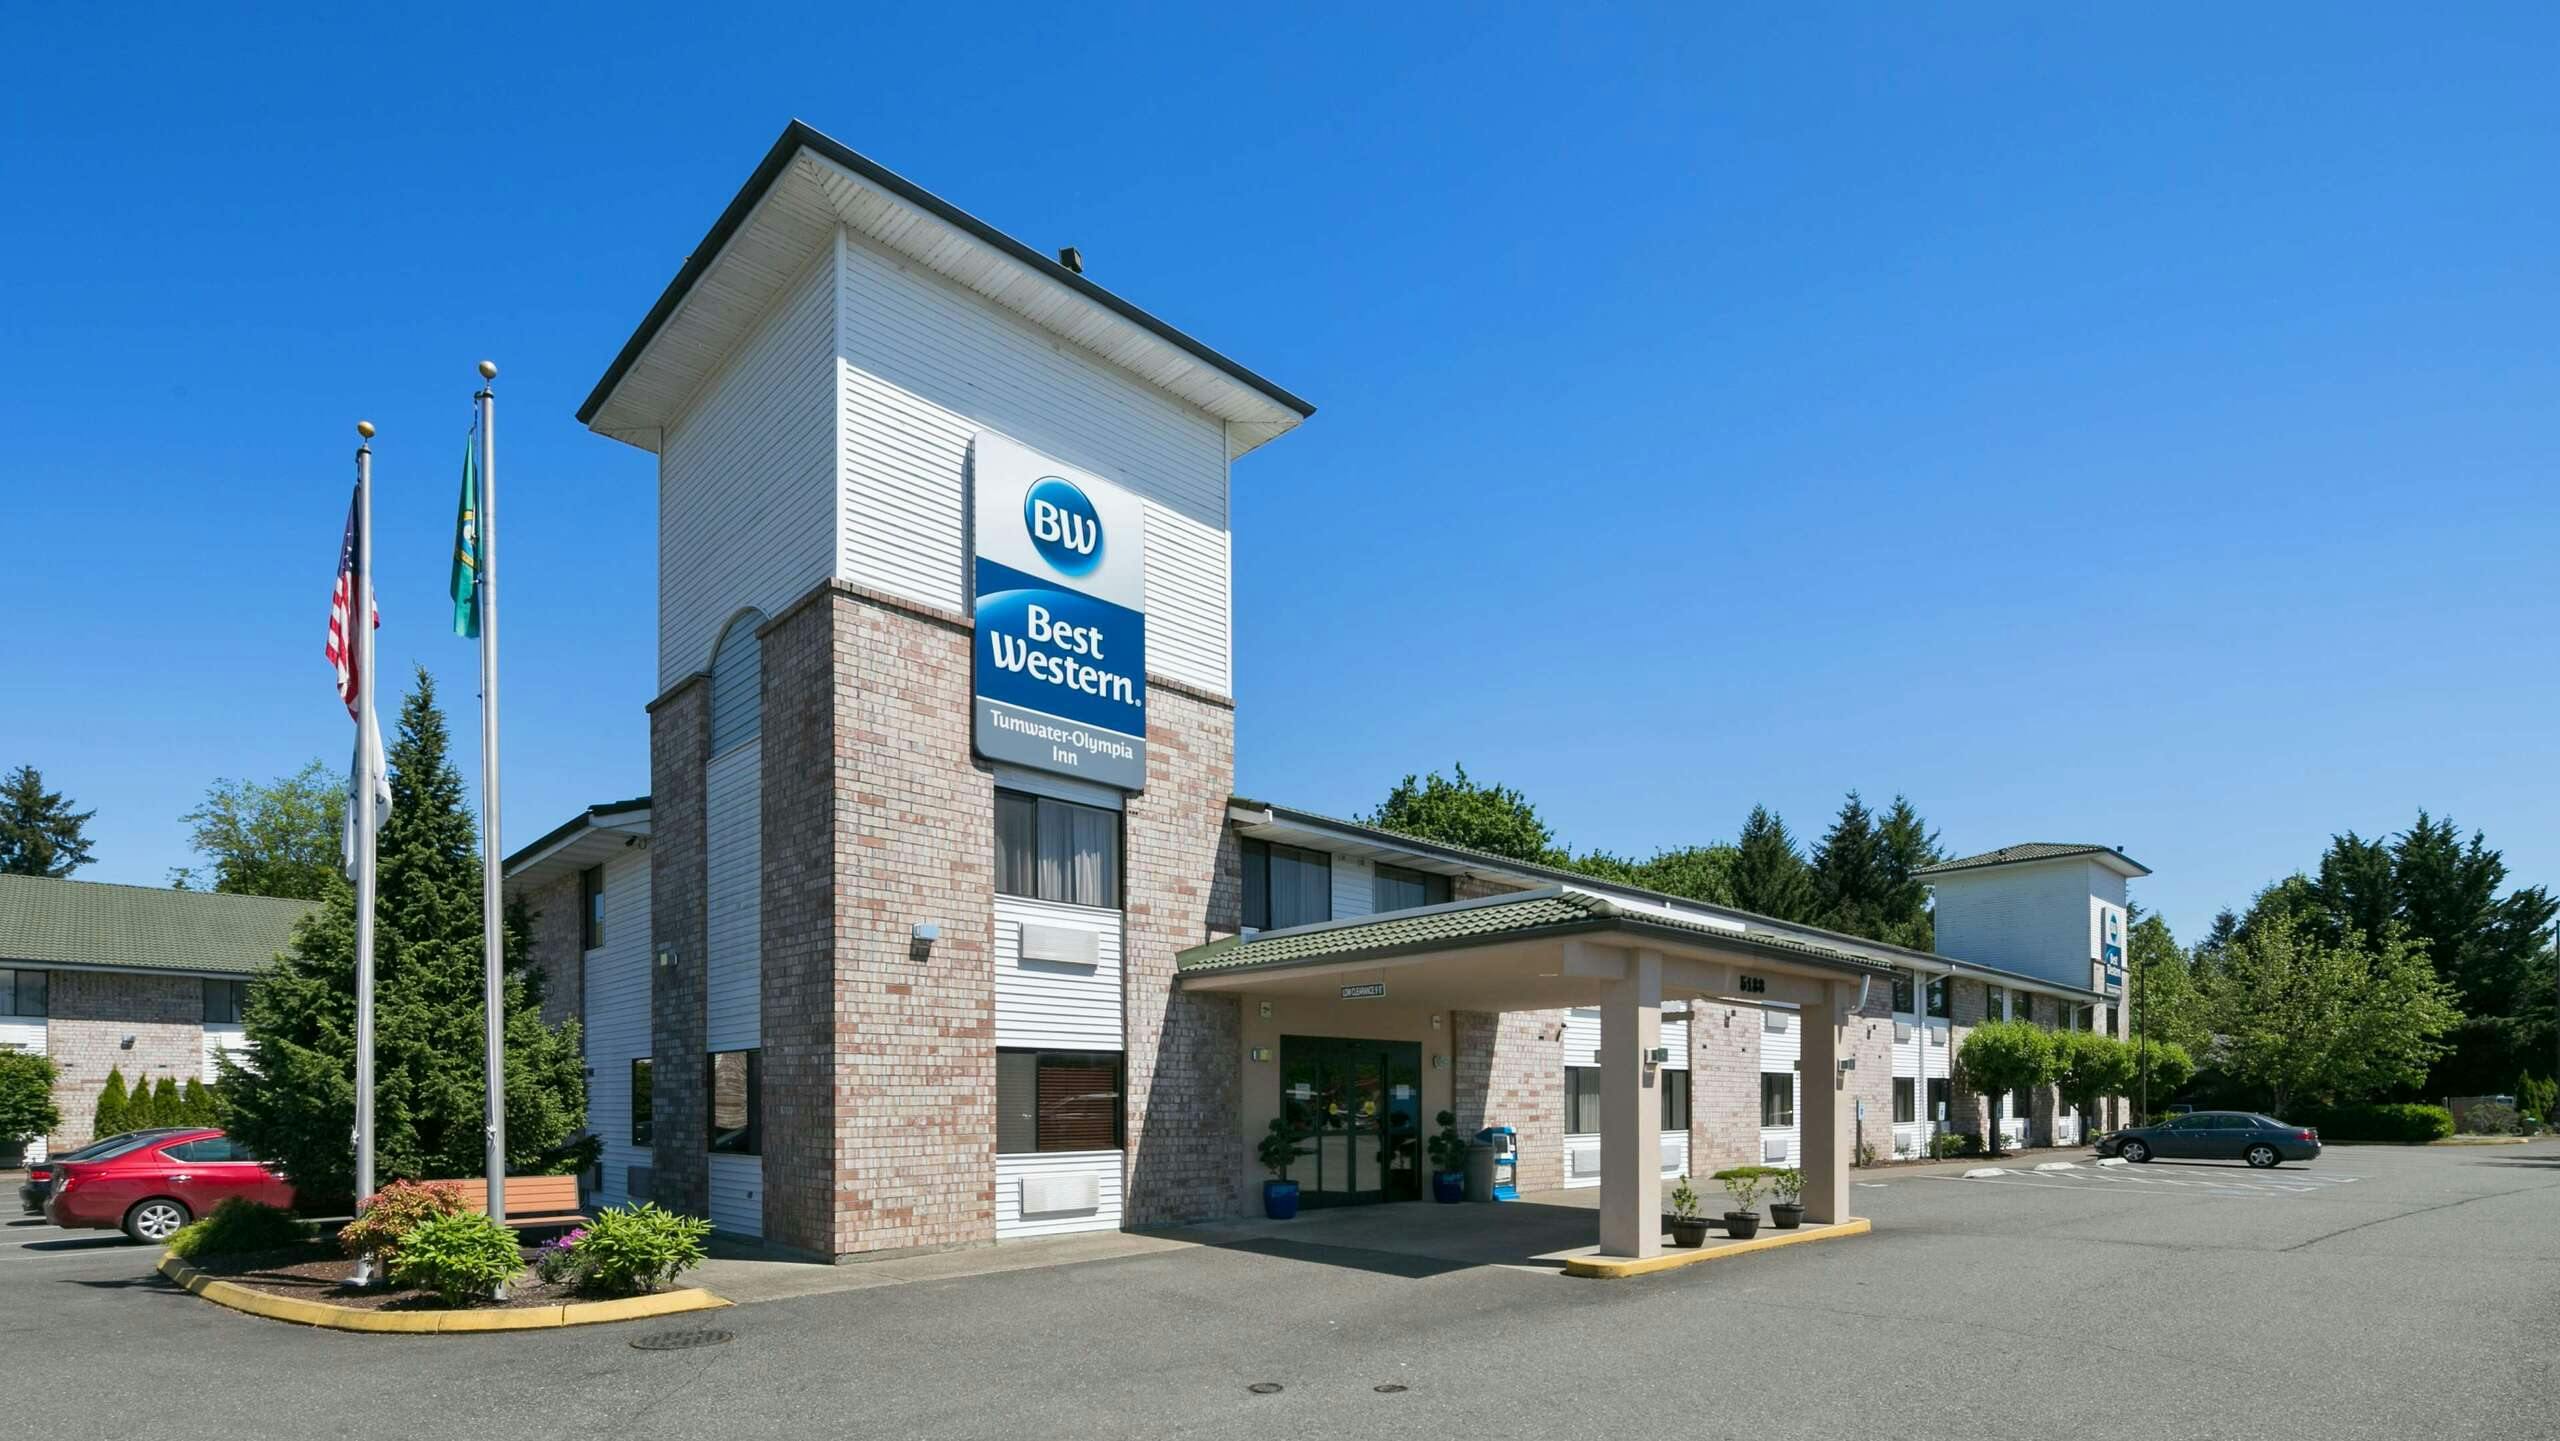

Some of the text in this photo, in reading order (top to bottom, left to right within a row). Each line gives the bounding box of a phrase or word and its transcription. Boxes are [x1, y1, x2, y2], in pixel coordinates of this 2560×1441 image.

[1034, 499, 1097, 555] BW
[1028, 603, 1105, 660] Best
[990, 709, 1134, 760] Tumwater-Olympia
[1052, 745, 1078, 766] Inn
